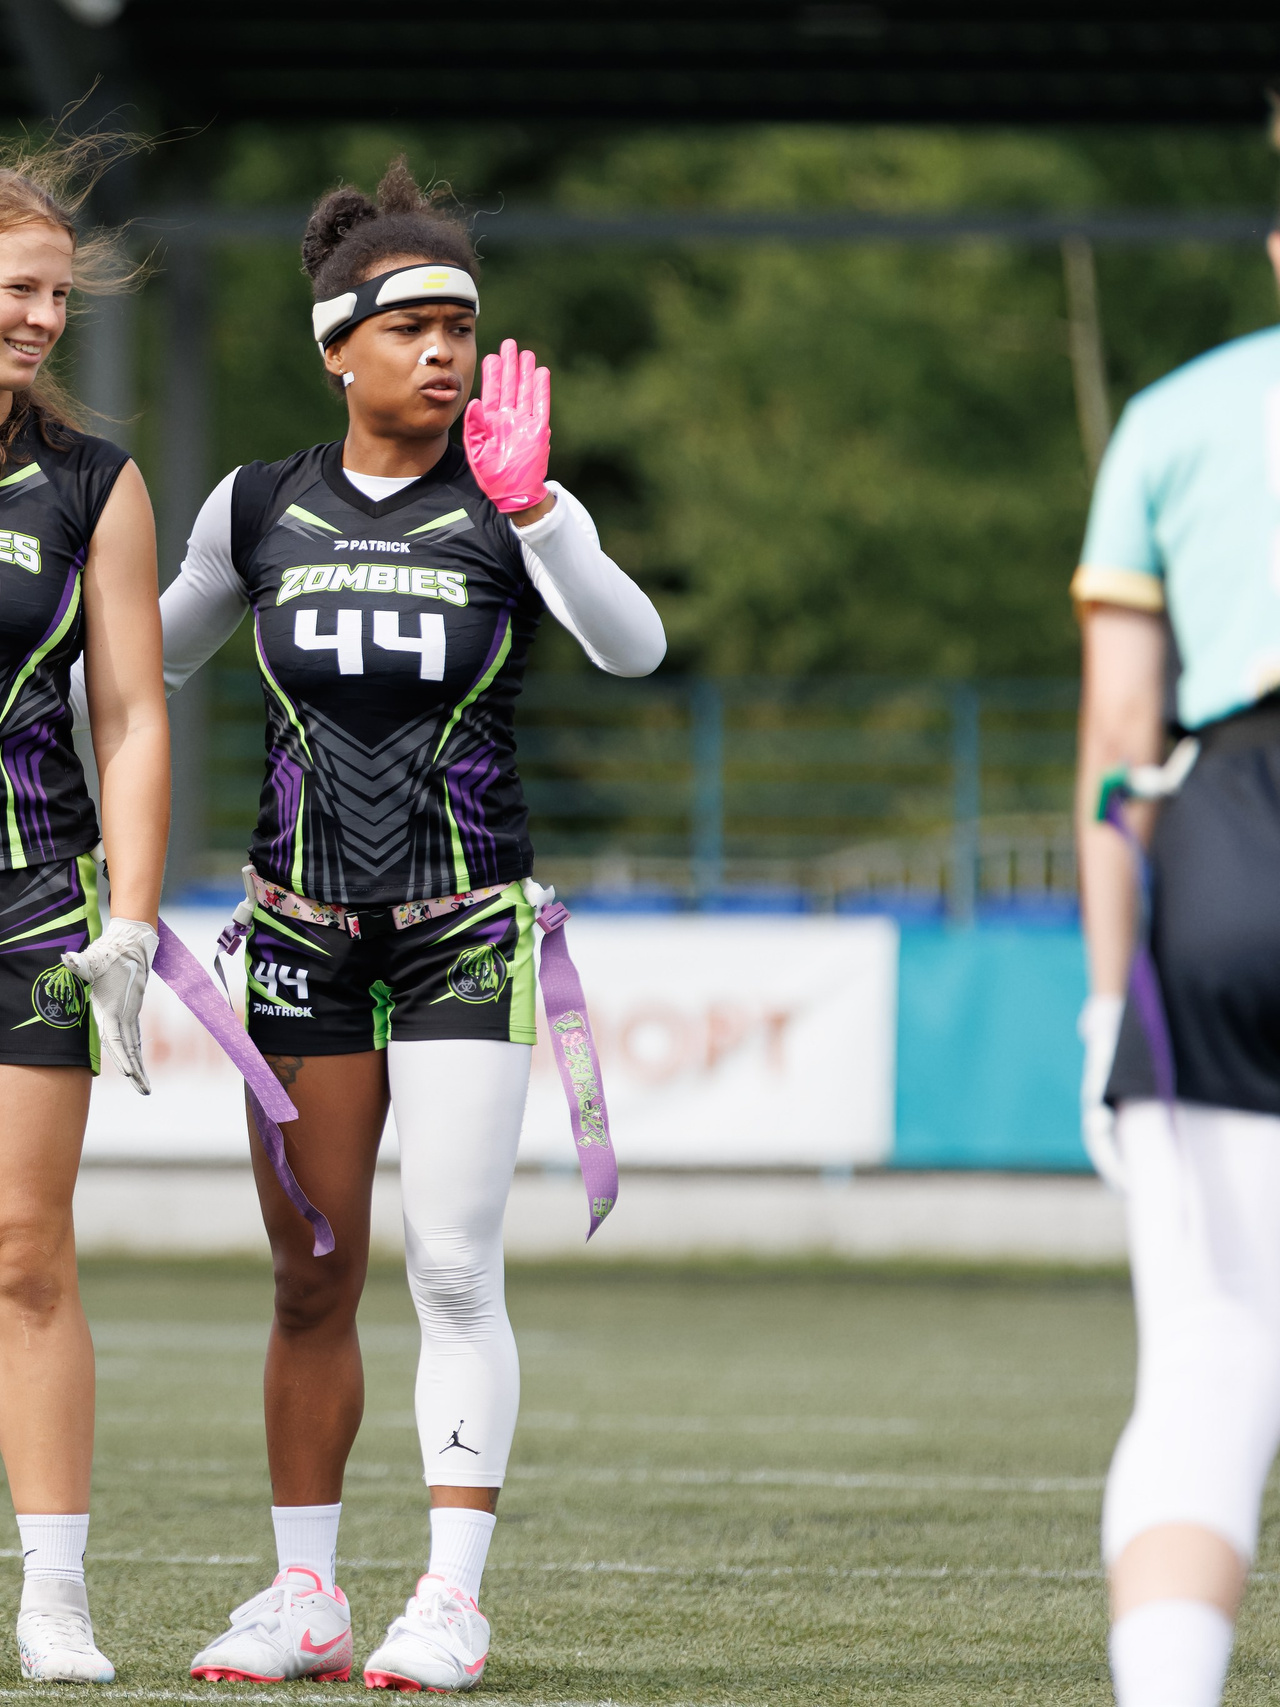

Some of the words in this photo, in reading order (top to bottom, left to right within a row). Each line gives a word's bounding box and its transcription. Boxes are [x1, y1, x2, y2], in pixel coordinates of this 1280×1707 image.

[349, 539, 411, 554] PATRICK
[276, 563, 469, 608] ZOMBIES
[293, 608, 447, 682] 44
[253, 961, 310, 1000] 44
[261, 1003, 314, 1018] PATRICK
